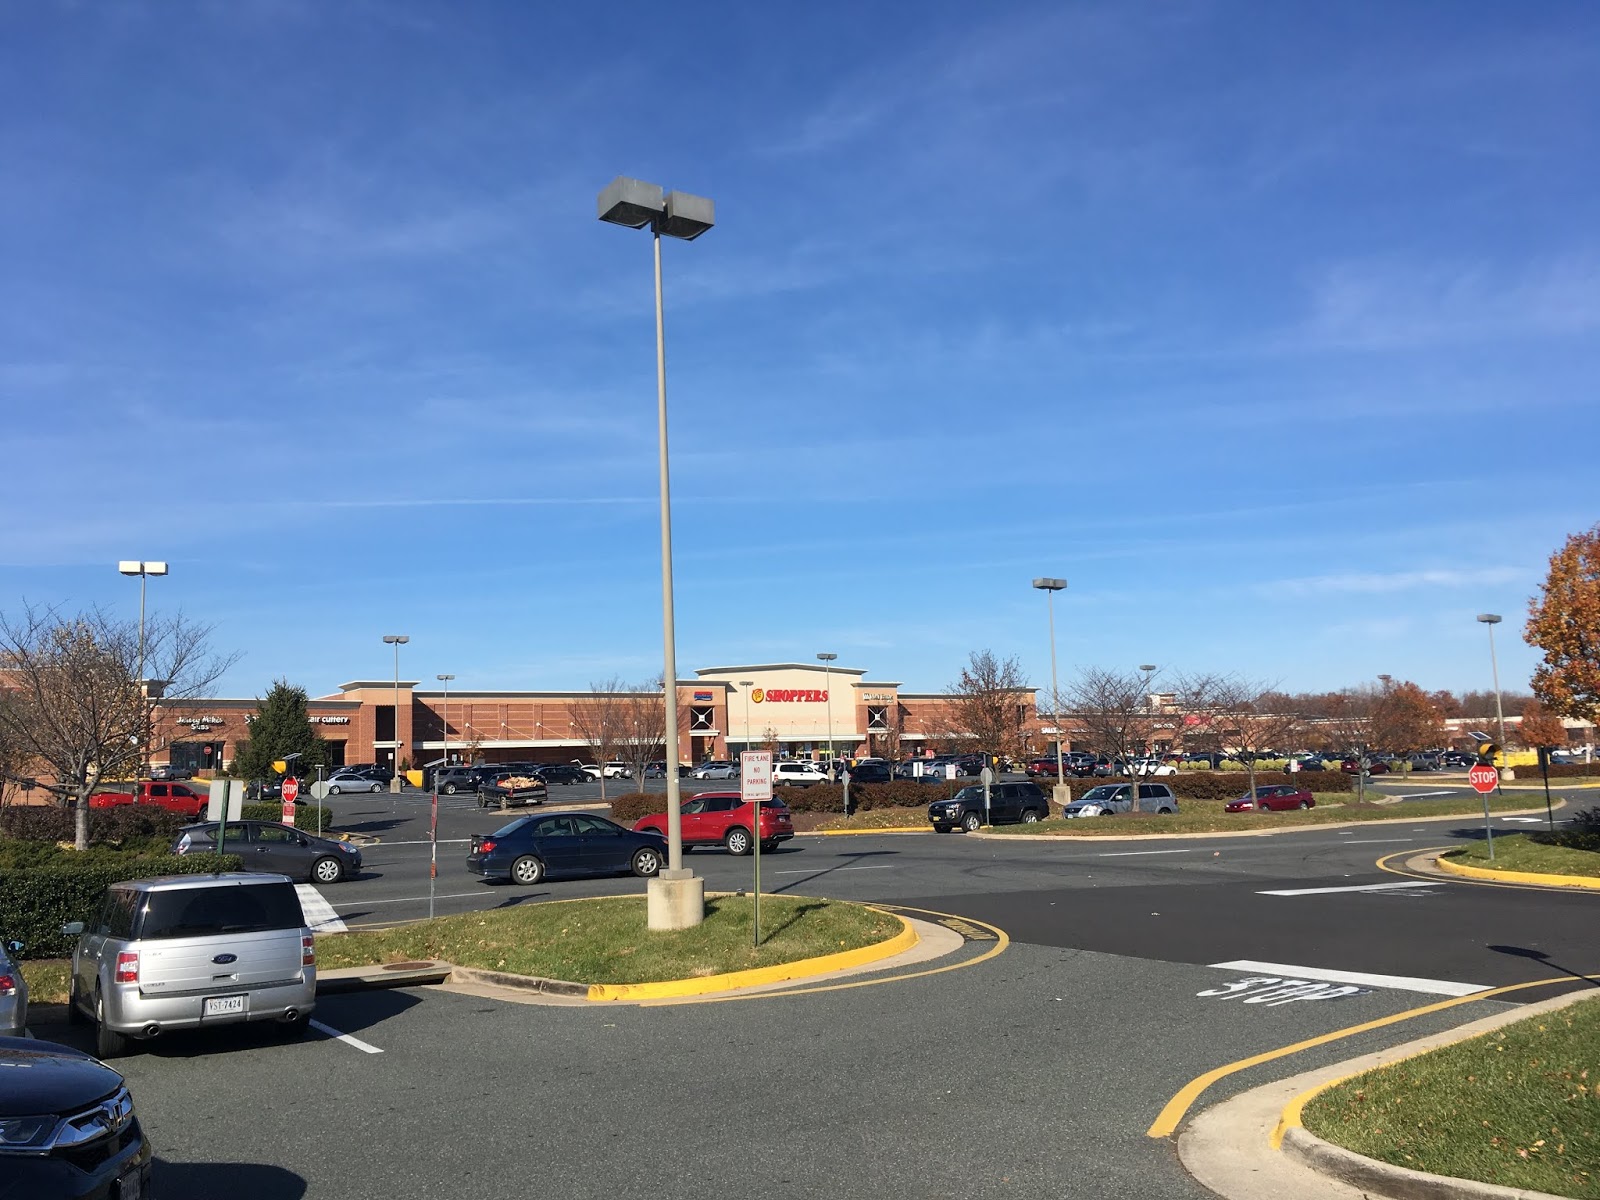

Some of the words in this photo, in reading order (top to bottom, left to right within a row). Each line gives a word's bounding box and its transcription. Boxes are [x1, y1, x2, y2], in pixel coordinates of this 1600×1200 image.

[765, 689, 829, 703] SHOPPERS
[321, 715, 349, 724] cuttery
[1471, 771, 1496, 784] STOP
[283, 784, 298, 795] STOP
[1196, 976, 1373, 1007] STOP
